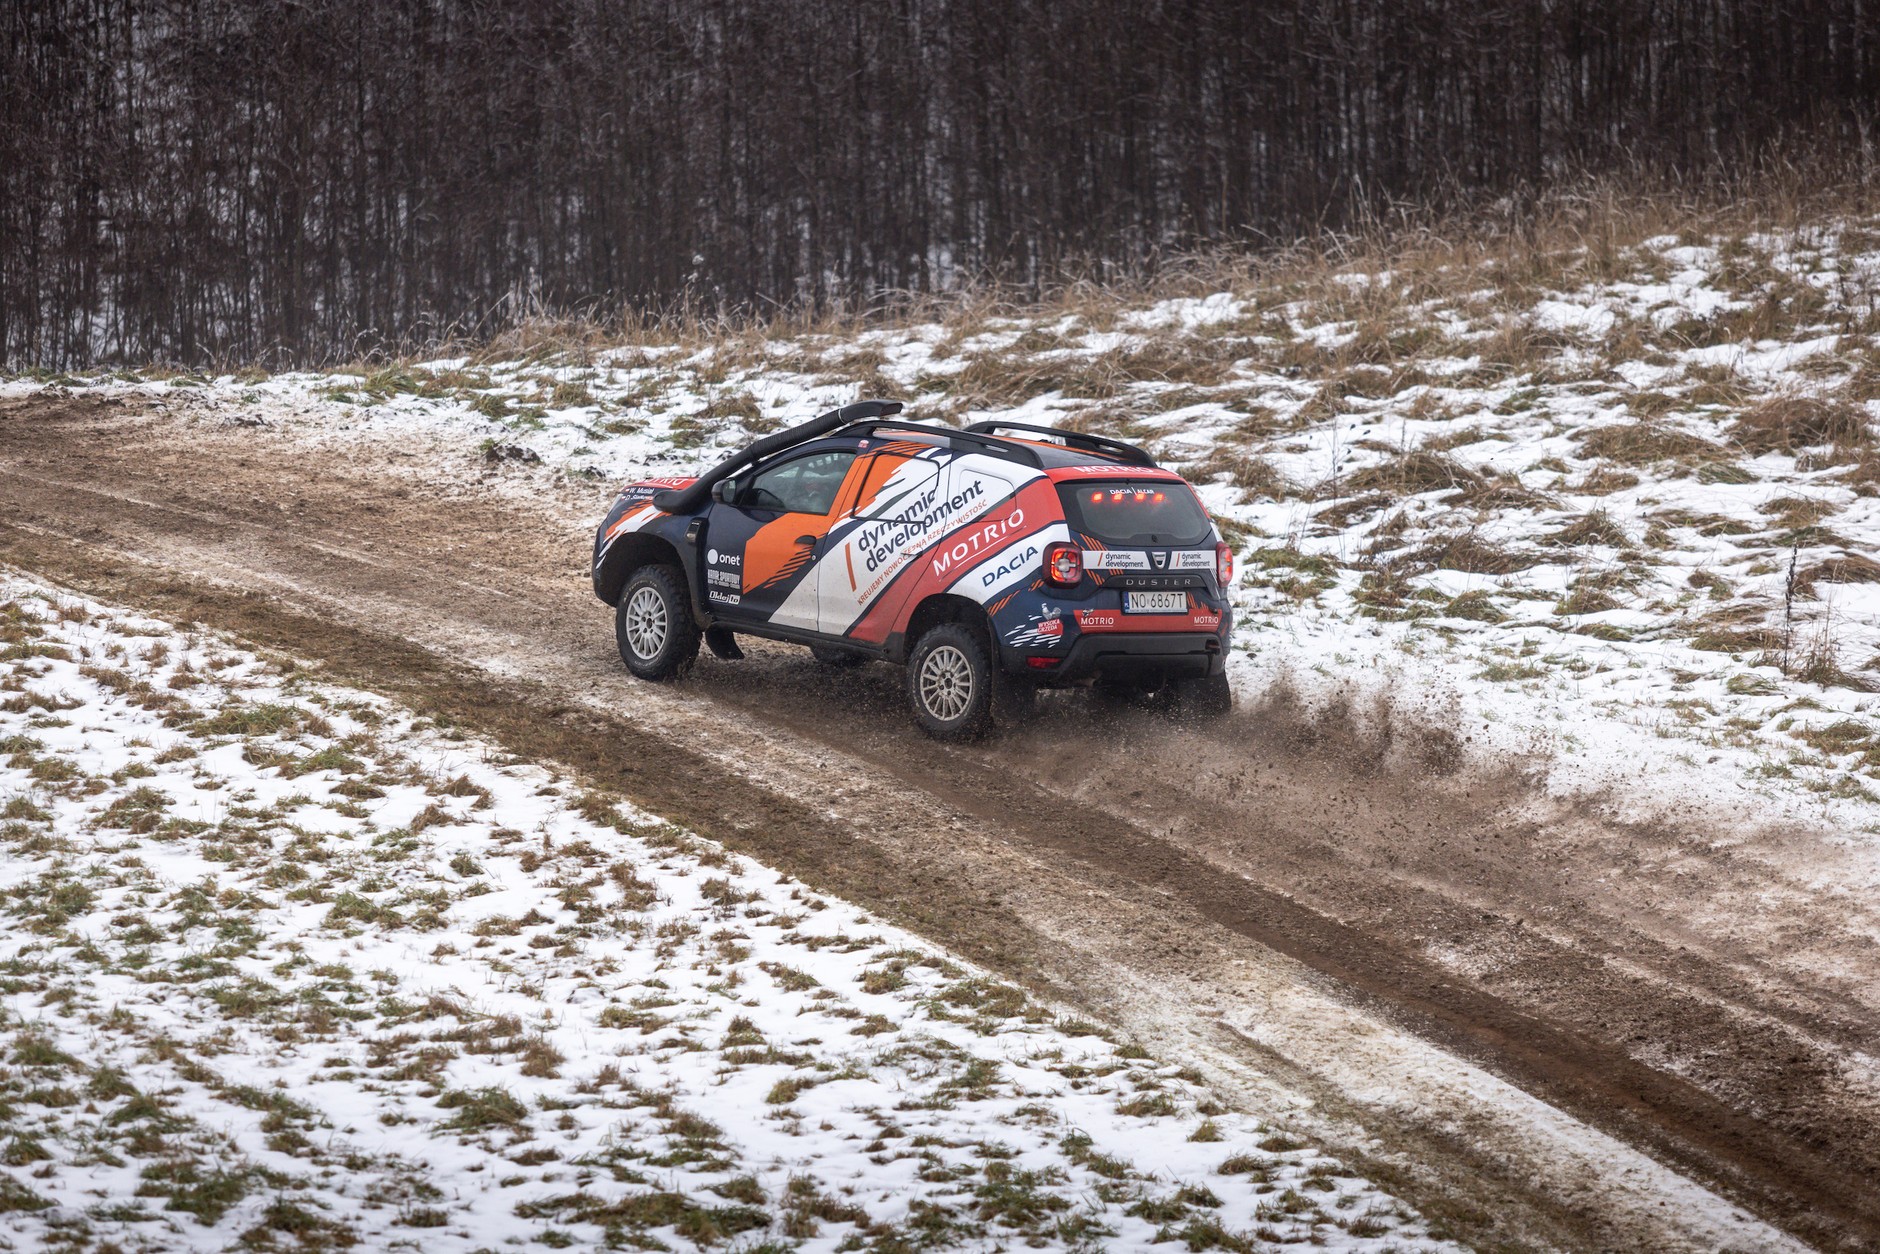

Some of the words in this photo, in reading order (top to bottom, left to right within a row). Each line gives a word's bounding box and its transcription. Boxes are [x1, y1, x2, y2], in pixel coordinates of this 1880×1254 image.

[858, 489, 936, 552] dynamic
[866, 480, 984, 572] development
[932, 508, 1025, 577] MOTRIO
[719, 554, 741, 566] onet
[1105, 552, 1131, 561] dynamic
[1181, 552, 1202, 560] dynamic
[982, 546, 1039, 588] DACIA
[1105, 560, 1144, 568] development
[857, 572, 885, 606] KREUJEMY
[1080, 617, 1114, 625] MOTRIO
[1193, 616, 1219, 624] MOTRIO
